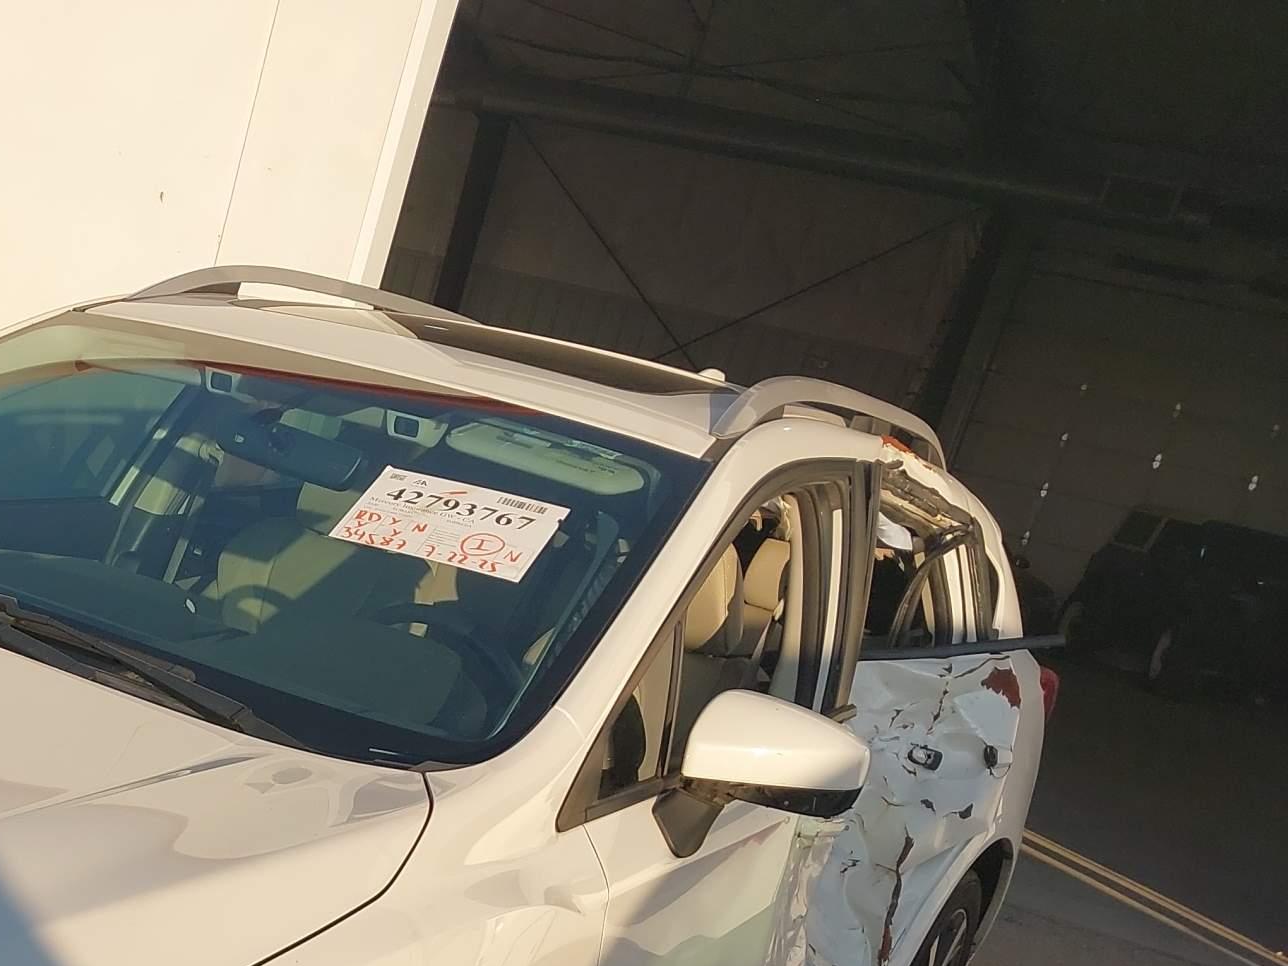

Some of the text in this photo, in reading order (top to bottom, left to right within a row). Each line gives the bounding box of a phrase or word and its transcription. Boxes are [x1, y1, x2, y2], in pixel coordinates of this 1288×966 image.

[386, 488, 536, 530] 42793767
[412, 524, 428, 532] N
[504, 550, 523, 562] N
